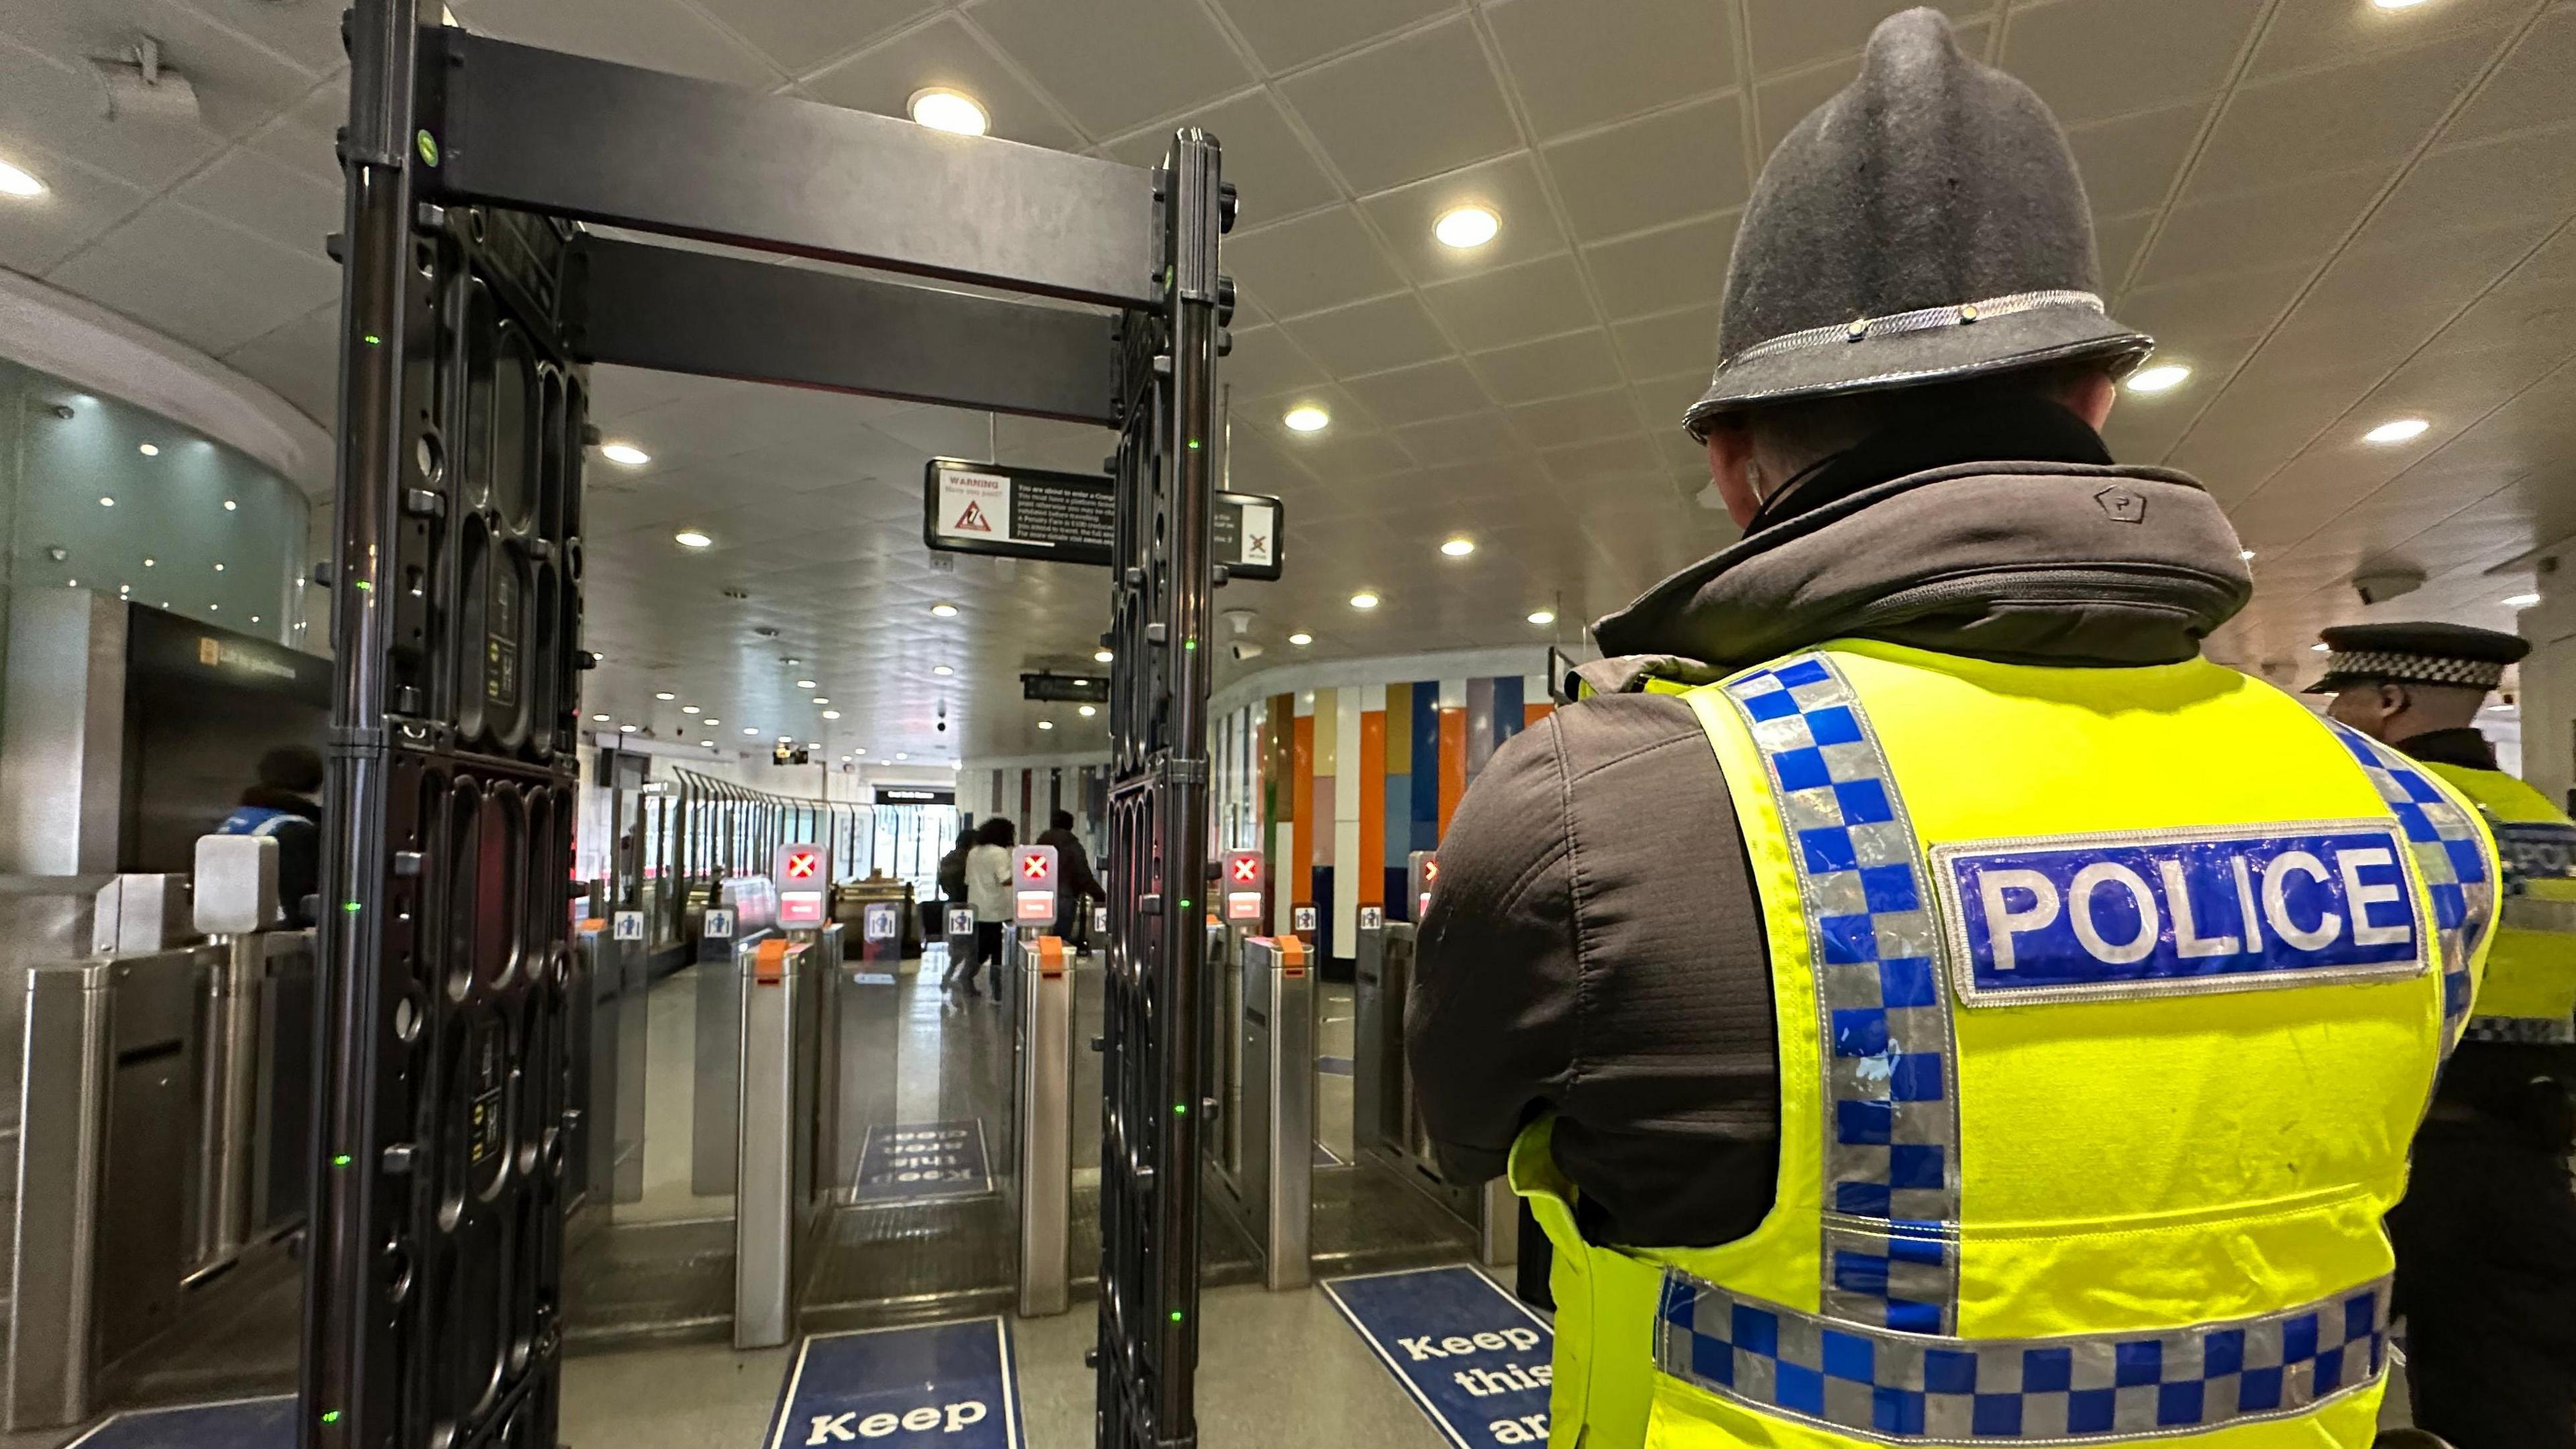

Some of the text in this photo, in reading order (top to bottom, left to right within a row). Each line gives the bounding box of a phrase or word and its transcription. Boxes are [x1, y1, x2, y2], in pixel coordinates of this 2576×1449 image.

[949, 476, 1000, 489] WARNING
[1979, 847, 2411, 970] POLICE
[1397, 1327, 1540, 1361] Keep
[1454, 1363, 1553, 1396] this
[806, 1401, 987, 1446] Keep
[1489, 1413, 1550, 1444] ar
